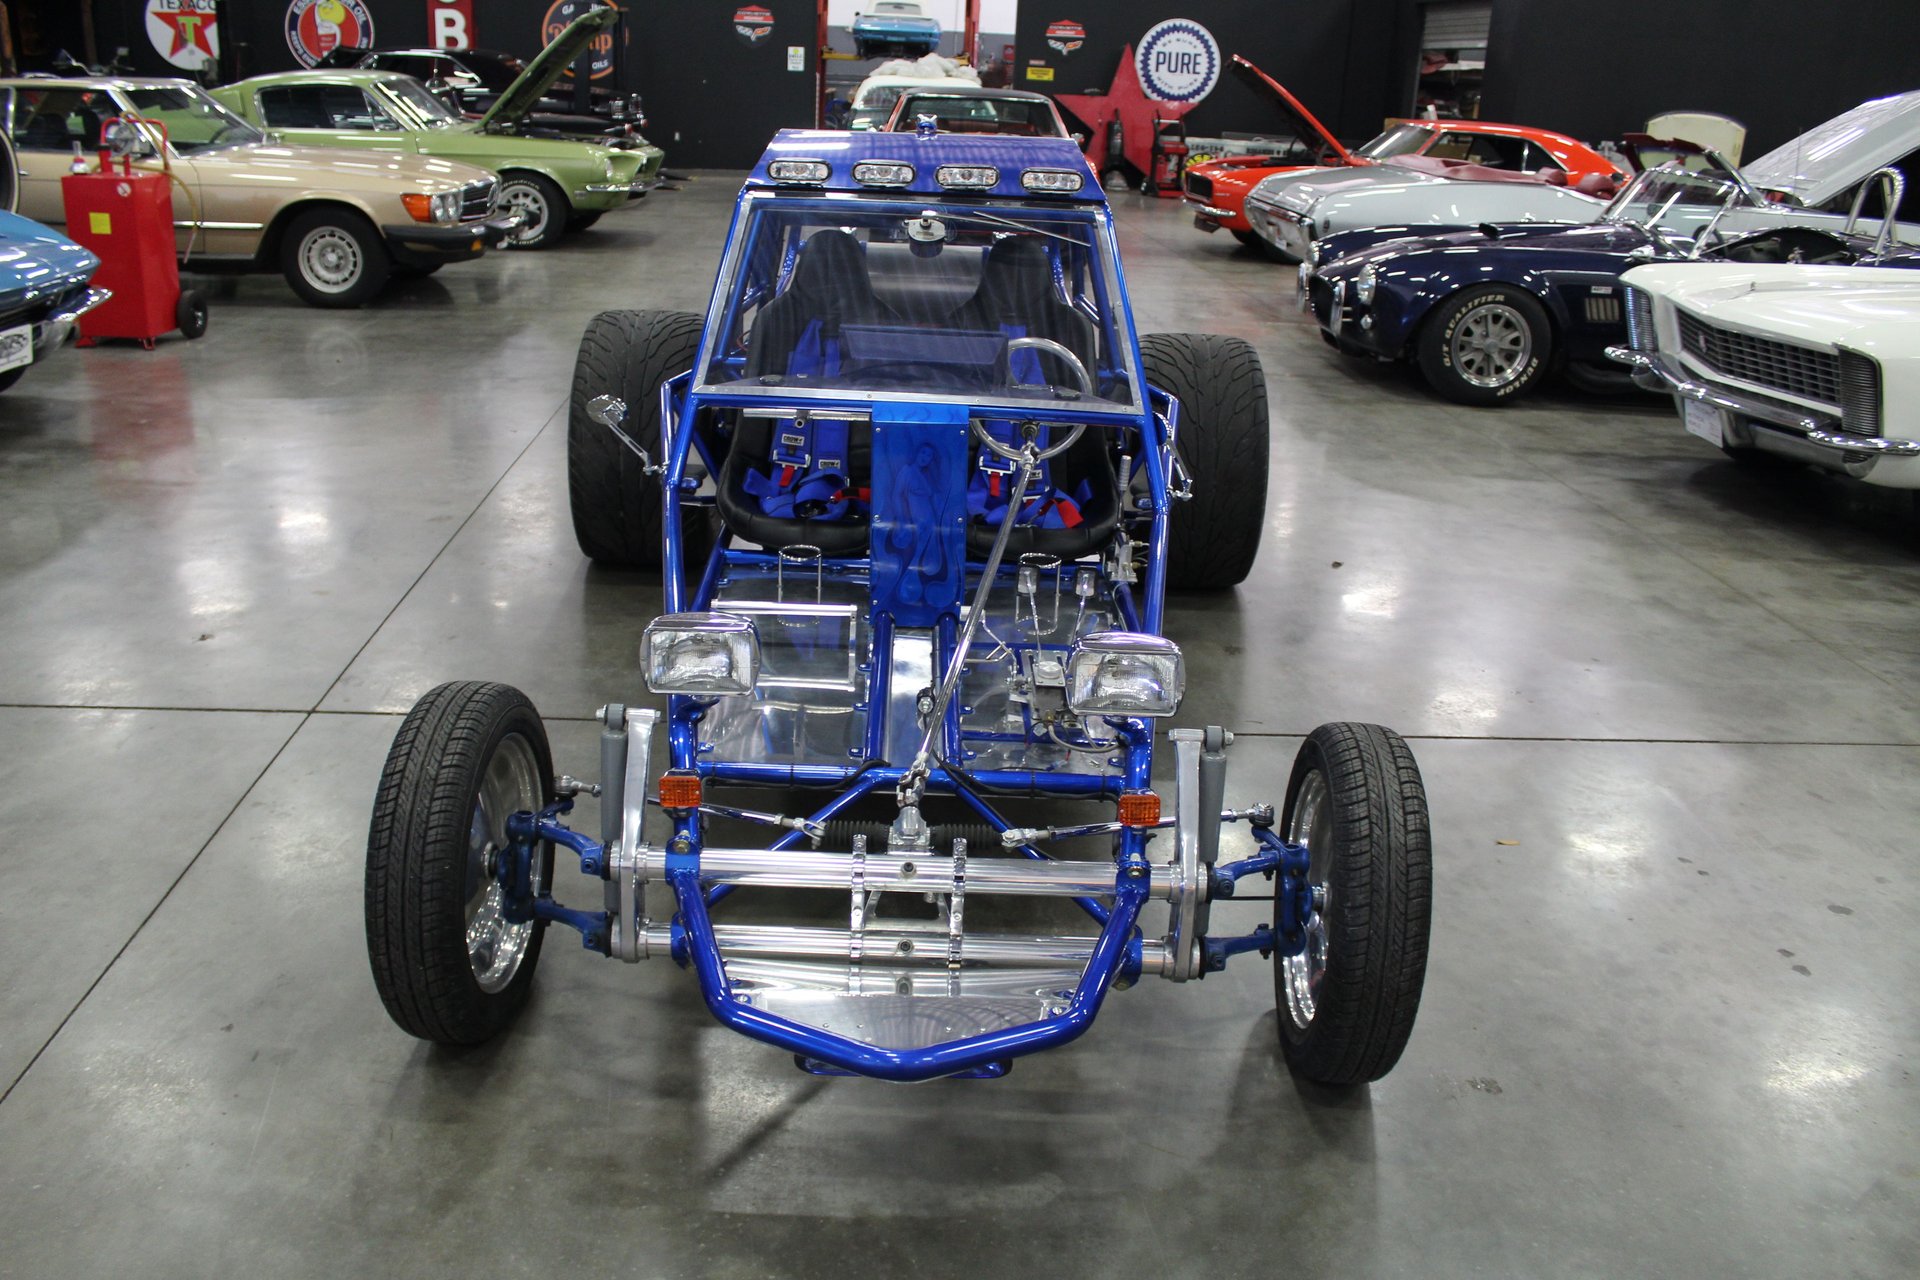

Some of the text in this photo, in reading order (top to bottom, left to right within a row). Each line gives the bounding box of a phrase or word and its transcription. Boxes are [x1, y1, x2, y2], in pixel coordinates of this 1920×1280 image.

[591, 59, 609, 70] OILS
[1155, 51, 1202, 75] PURE
[1444, 294, 1505, 340] QUALIFIER
[1496, 356, 1539, 397] DUNLOP
